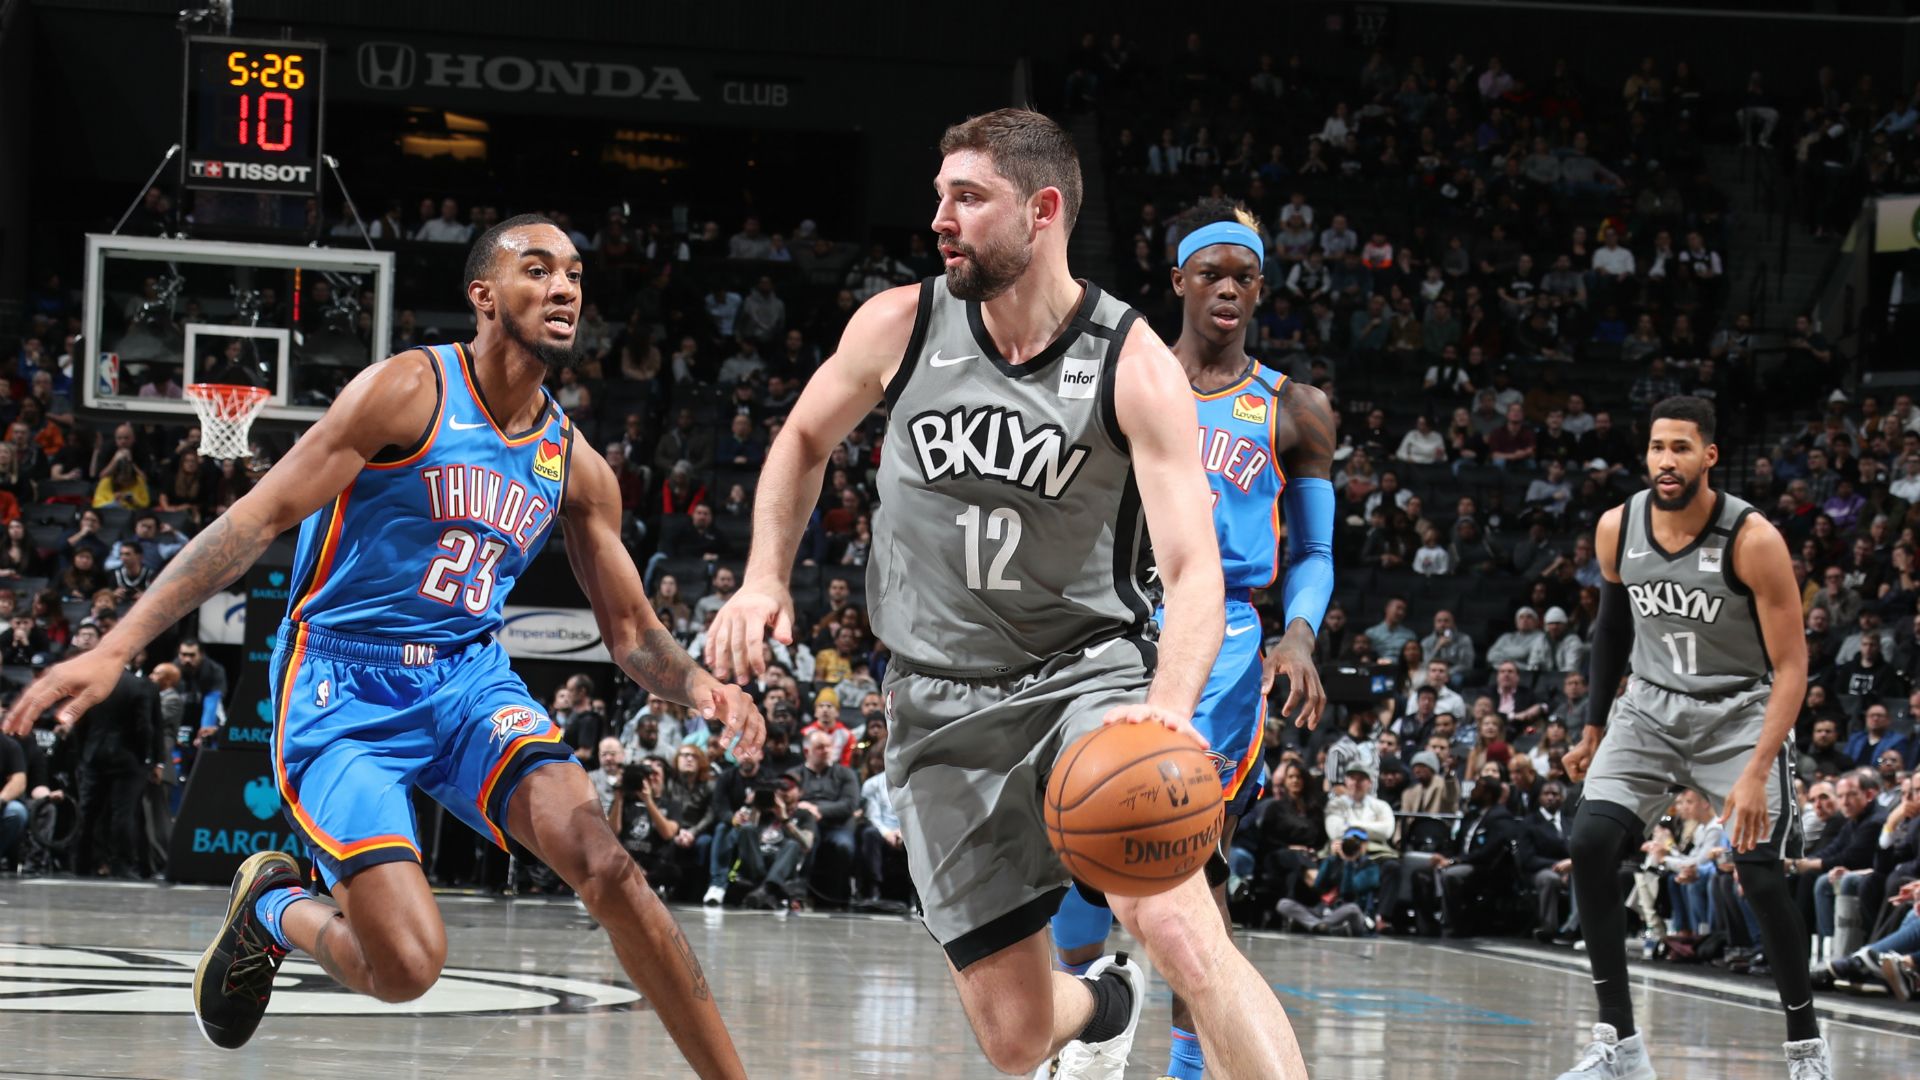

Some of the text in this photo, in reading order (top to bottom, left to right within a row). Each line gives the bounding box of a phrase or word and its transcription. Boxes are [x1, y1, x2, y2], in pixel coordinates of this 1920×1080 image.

[228, 51, 305, 90] 5:26
[424, 52, 700, 101] HONDA
[723, 82, 790, 107] CLUB
[239, 91, 293, 151] 10
[224, 161, 311, 183] TISSOT
[1063, 370, 1096, 384] infor
[908, 405, 1092, 500] BKLYN
[956, 504, 1022, 591] 12
[417, 526, 510, 616] 23
[1627, 579, 1724, 625] BKLYN
[404, 643, 437, 666] OKC
[508, 627, 592, 641] ImperialDade
[1661, 631, 1698, 675] 17
[501, 710, 529, 736] OKC
[1123, 808, 1223, 865] SPALDING
